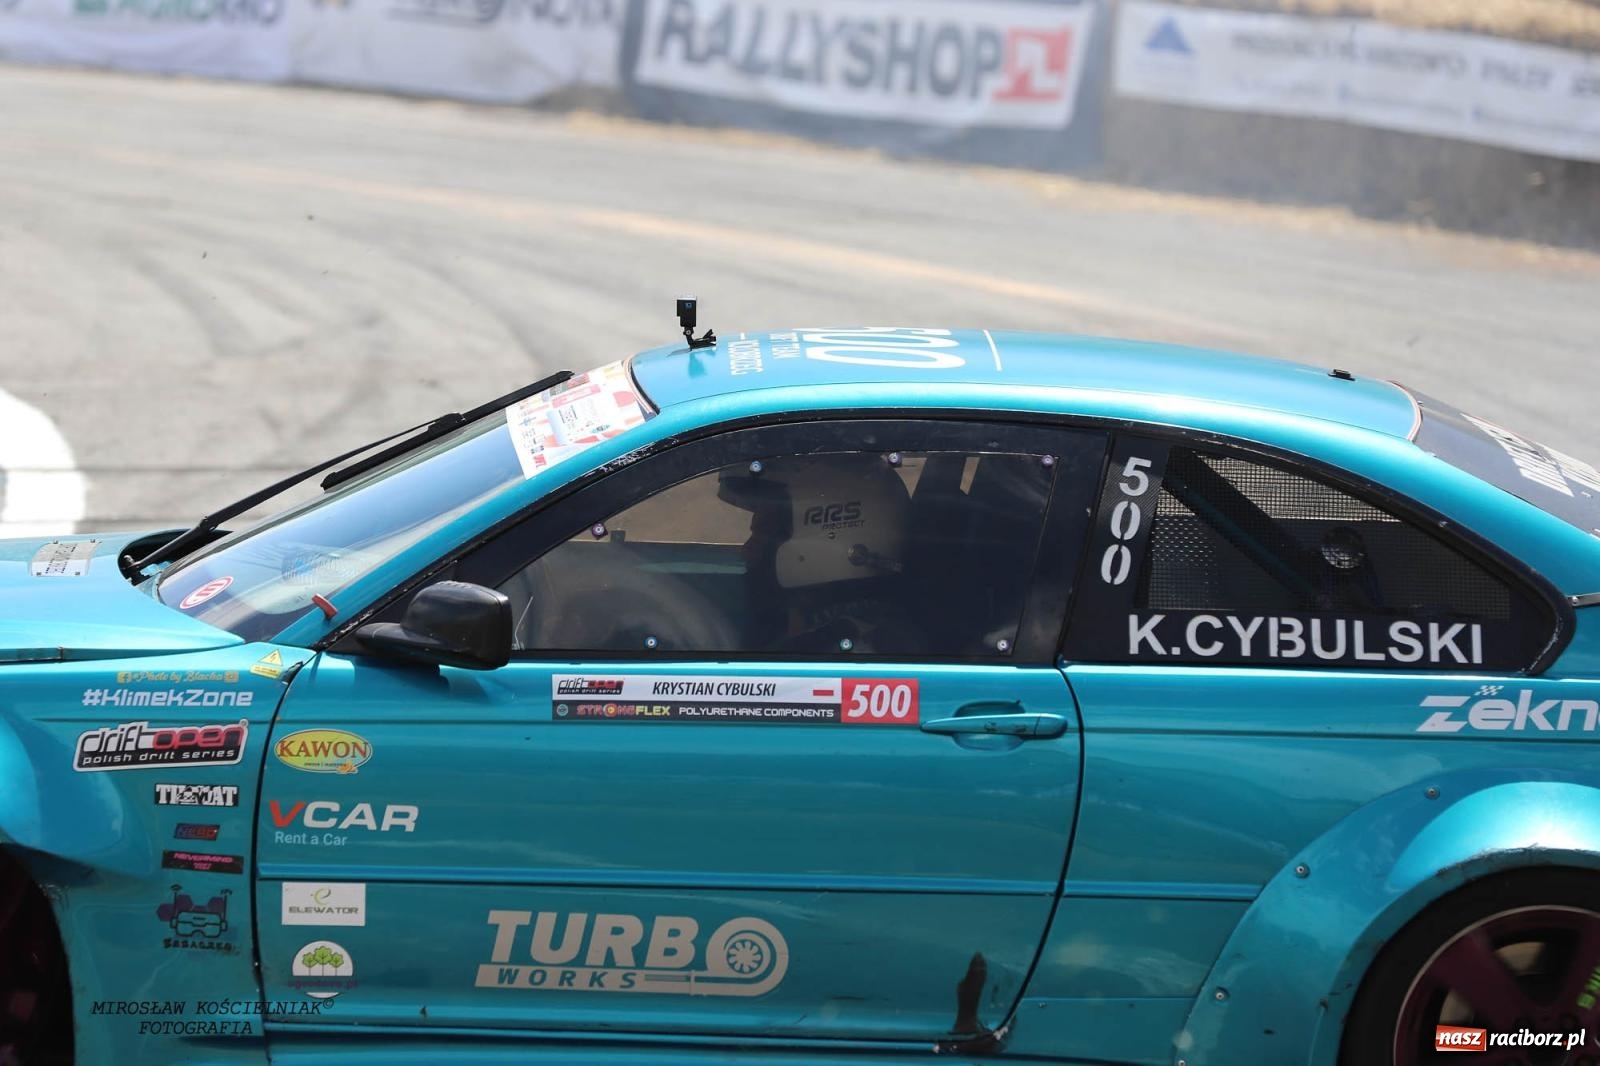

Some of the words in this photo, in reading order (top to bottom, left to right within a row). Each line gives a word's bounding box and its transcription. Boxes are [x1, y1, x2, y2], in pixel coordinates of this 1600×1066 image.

[1101, 457, 1152, 585] 500
[1128, 614, 1483, 665] K.CYBULSKI
[652, 682, 714, 697] KRYSTIAN
[717, 682, 776, 697] CYBULSKI
[848, 684, 912, 718] 500
[679, 706, 762, 716] POLYURETHANE
[764, 707, 834, 718] COMPONENTS
[82, 753, 132, 766] polish
[138, 751, 176, 761] drift
[181, 749, 235, 759] series
[278, 740, 368, 758] KAWON
[275, 831, 307, 844] Rent
[310, 835, 319, 845] a
[323, 833, 347, 846] Car
[288, 906, 359, 914] ELEWATOR
[497, 968, 637, 989] WORKS
